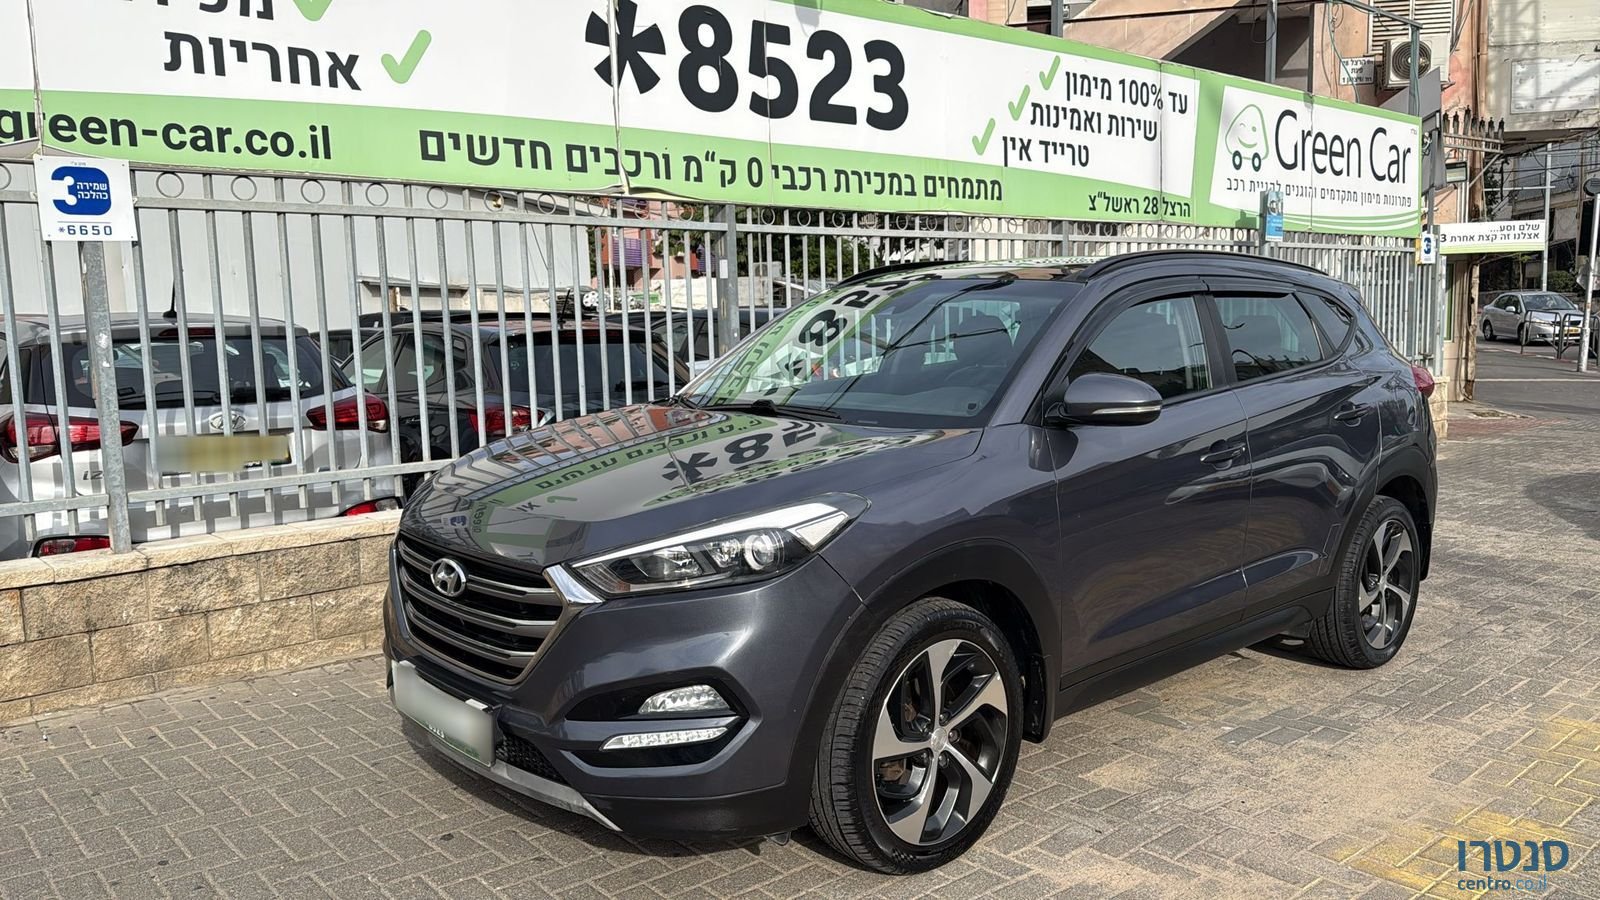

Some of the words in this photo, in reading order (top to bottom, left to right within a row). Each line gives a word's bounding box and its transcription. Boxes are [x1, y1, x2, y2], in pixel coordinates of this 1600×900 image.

[164, 31, 361, 91] אחריות
[1065, 71, 1112, 101] מימון
[1118, 79, 1164, 111] 100%
[1168, 91, 1188, 115] עד
[1030, 102, 1101, 134] ואמינות
[1108, 115, 1158, 142] שירות
[419, 130, 552, 171] חדשים
[1003, 136, 1032, 167] אין
[1039, 140, 1090, 167] טרייד
[1275, 110, 1362, 177] Green
[1370, 127, 1411, 184] Car
[565, 143, 671, 180] ורכבים
[683, 150, 736, 187] ק"מ
[747, 158, 763, 187] 0
[76, 182, 108, 190] שמירה
[771, 164, 826, 193] רכבי
[835, 168, 917, 201] במכירת
[925, 178, 1002, 202] מתמחים
[1227, 178, 1245, 192] רכב
[77, 191, 109, 199] כהלכה
[1285, 184, 1317, 199] והוגנים
[1320, 187, 1358, 202] מתקדמים
[1361, 191, 1380, 206] מימון
[1383, 194, 1412, 207] פתרונות
[1088, 193, 1139, 215] ראשל"צ
[1143, 196, 1159, 215] 28
[1163, 198, 1191, 218] הרצל
[1478, 234, 1497, 242] קצת
[1513, 232, 1540, 240] אצלנו
[1519, 223, 1540, 231] שלם
[83, 470, 104, 480] i2
